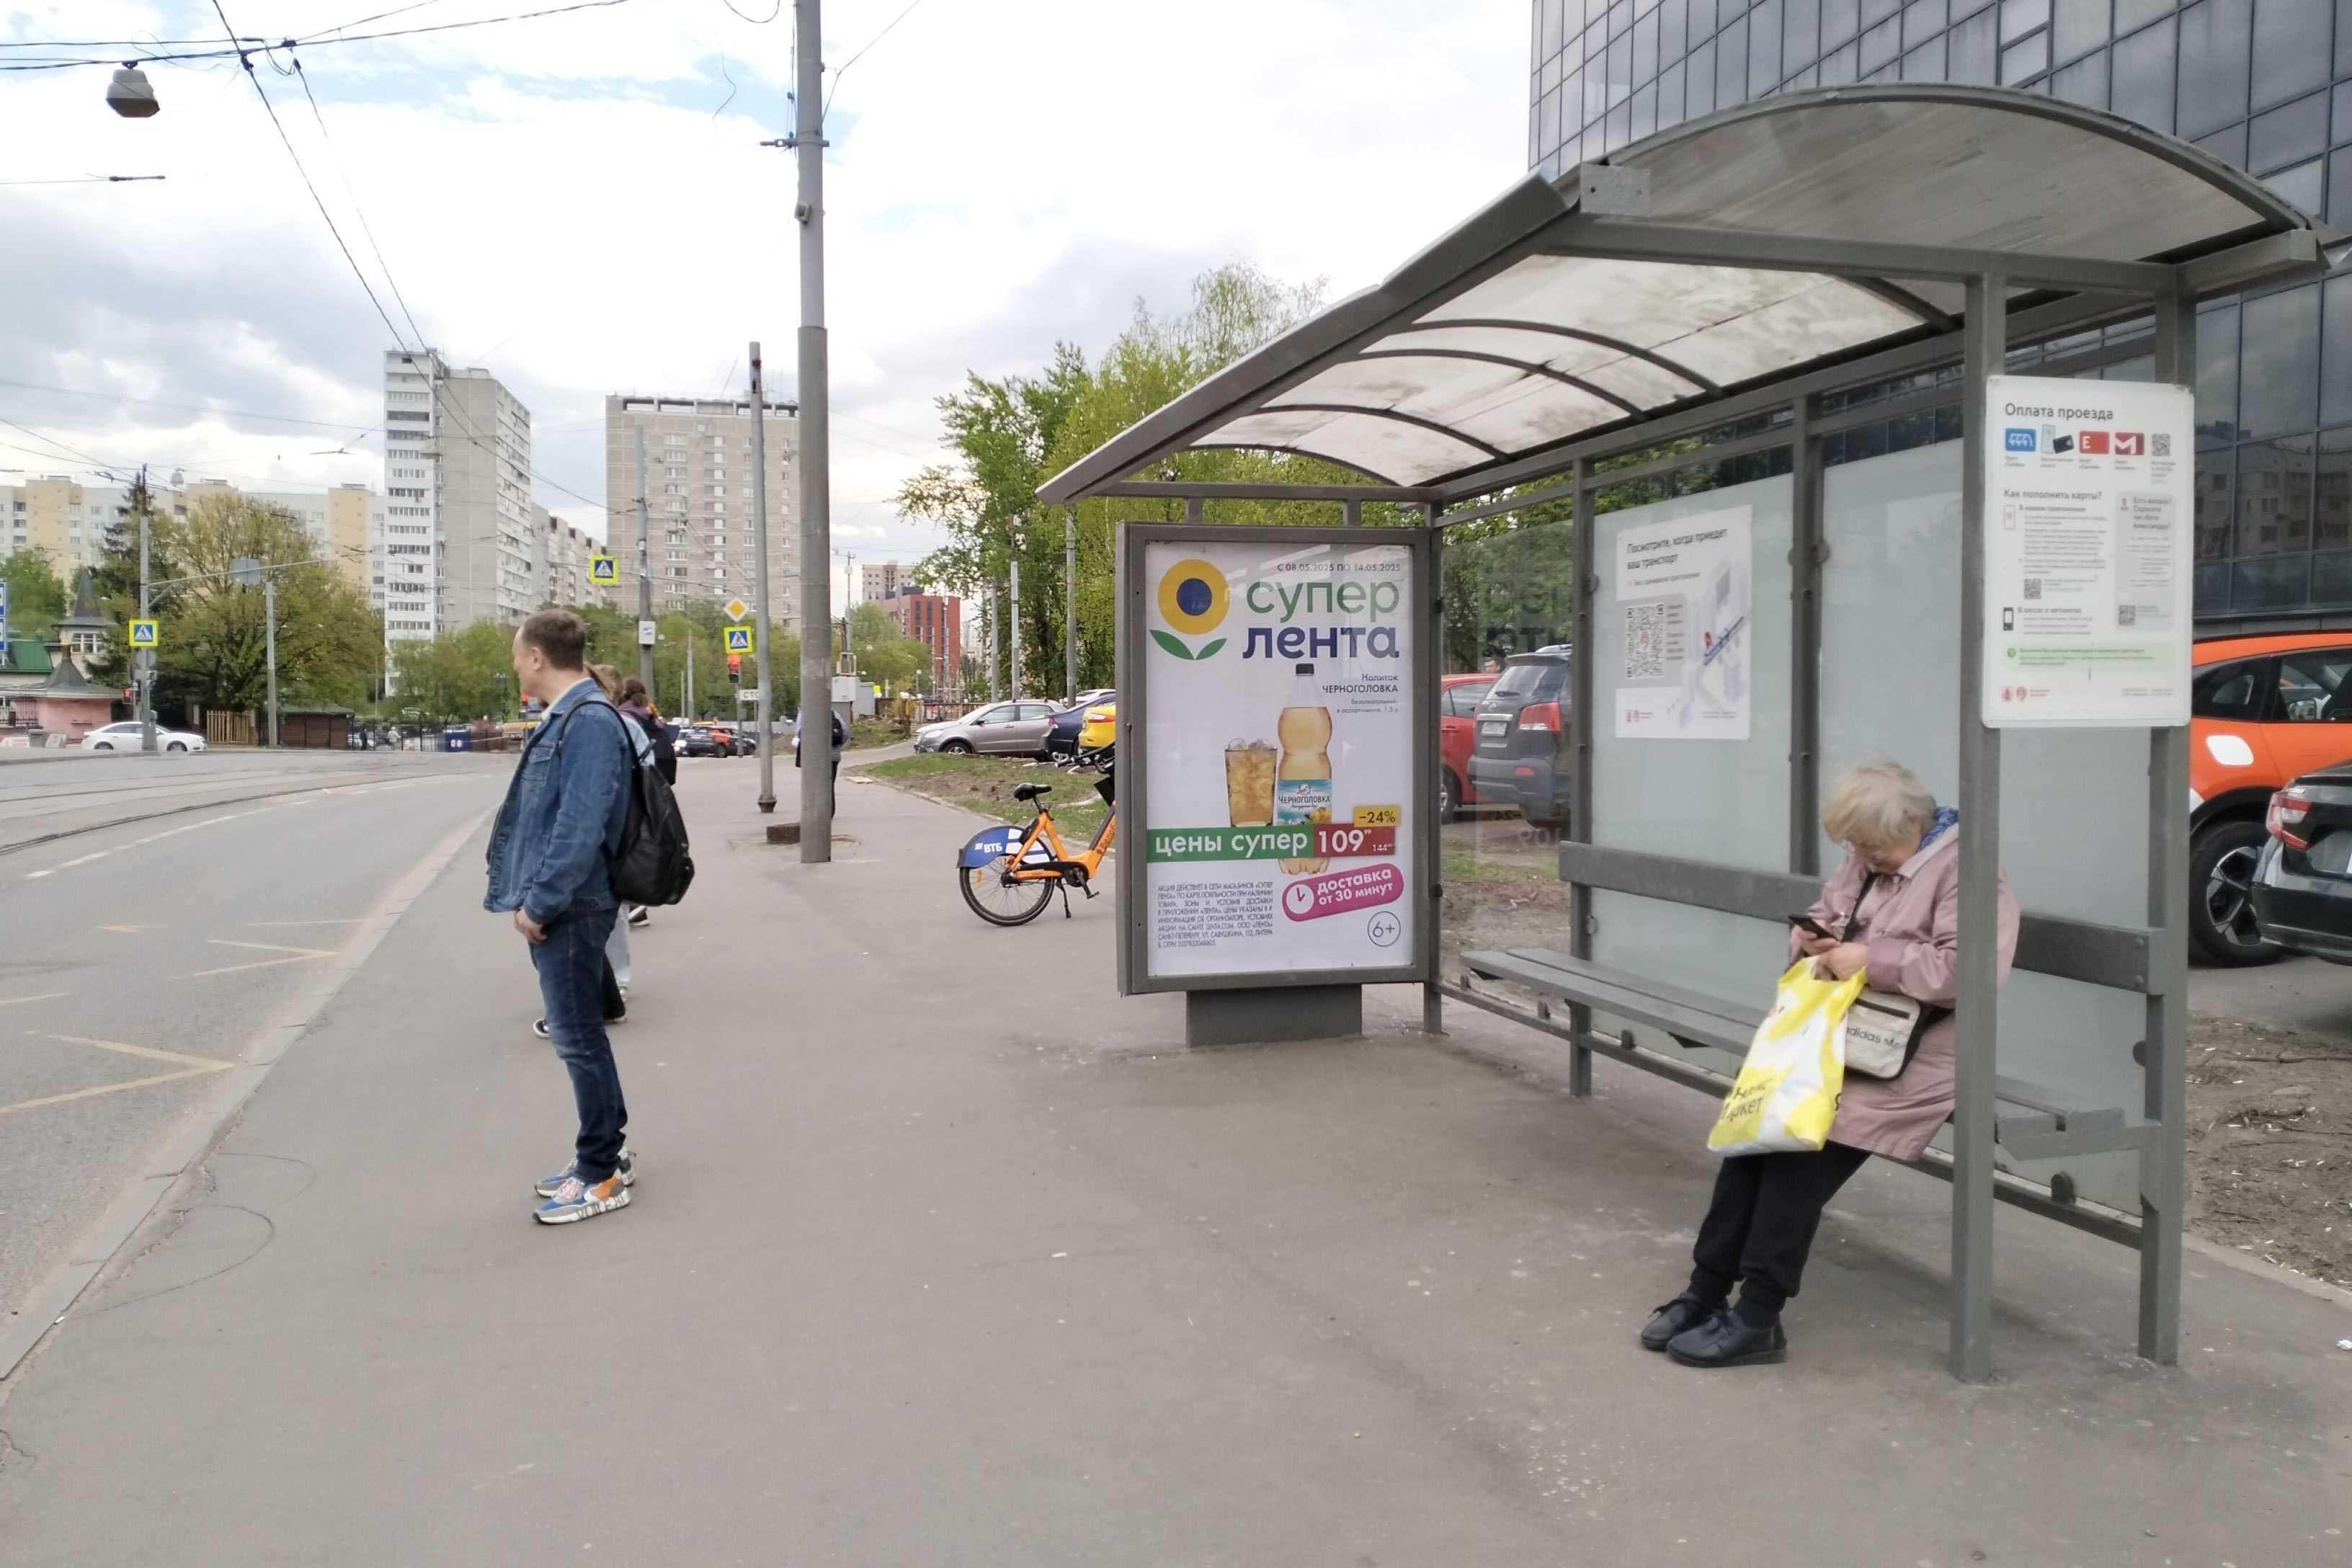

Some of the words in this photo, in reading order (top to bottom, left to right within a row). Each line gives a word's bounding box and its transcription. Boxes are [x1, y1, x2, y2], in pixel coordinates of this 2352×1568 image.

[2005, 403, 2054, 417] Оплата
[2058, 406, 2114, 421] проезда
[2003, 489, 2020, 498] Как
[2023, 491, 2070, 499] пополнить
[2072, 491, 2103, 501] карты?
[1246, 581, 1400, 623] супер
[1242, 626, 1400, 659] лента
[1361, 673, 1399, 682] Напиток
[1322, 685, 1399, 693] ЧЕРНОГОЛОВКА
[1278, 795, 1332, 804] ЧЕРНОГОЛОВКА
[1359, 811, 1396, 824] -24%
[984, 842, 1002, 853] ВТБ
[1155, 835, 1221, 857] цены
[1231, 832, 1308, 858] супер
[1318, 829, 1364, 853] 109
[1317, 869, 1392, 896] доставка
[1319, 895, 1333, 905] от
[1335, 888, 1352, 901] 30
[1355, 883, 1393, 899] минут
[1373, 921, 1396, 937] 6+
[1846, 1027, 1881, 1043] didas
